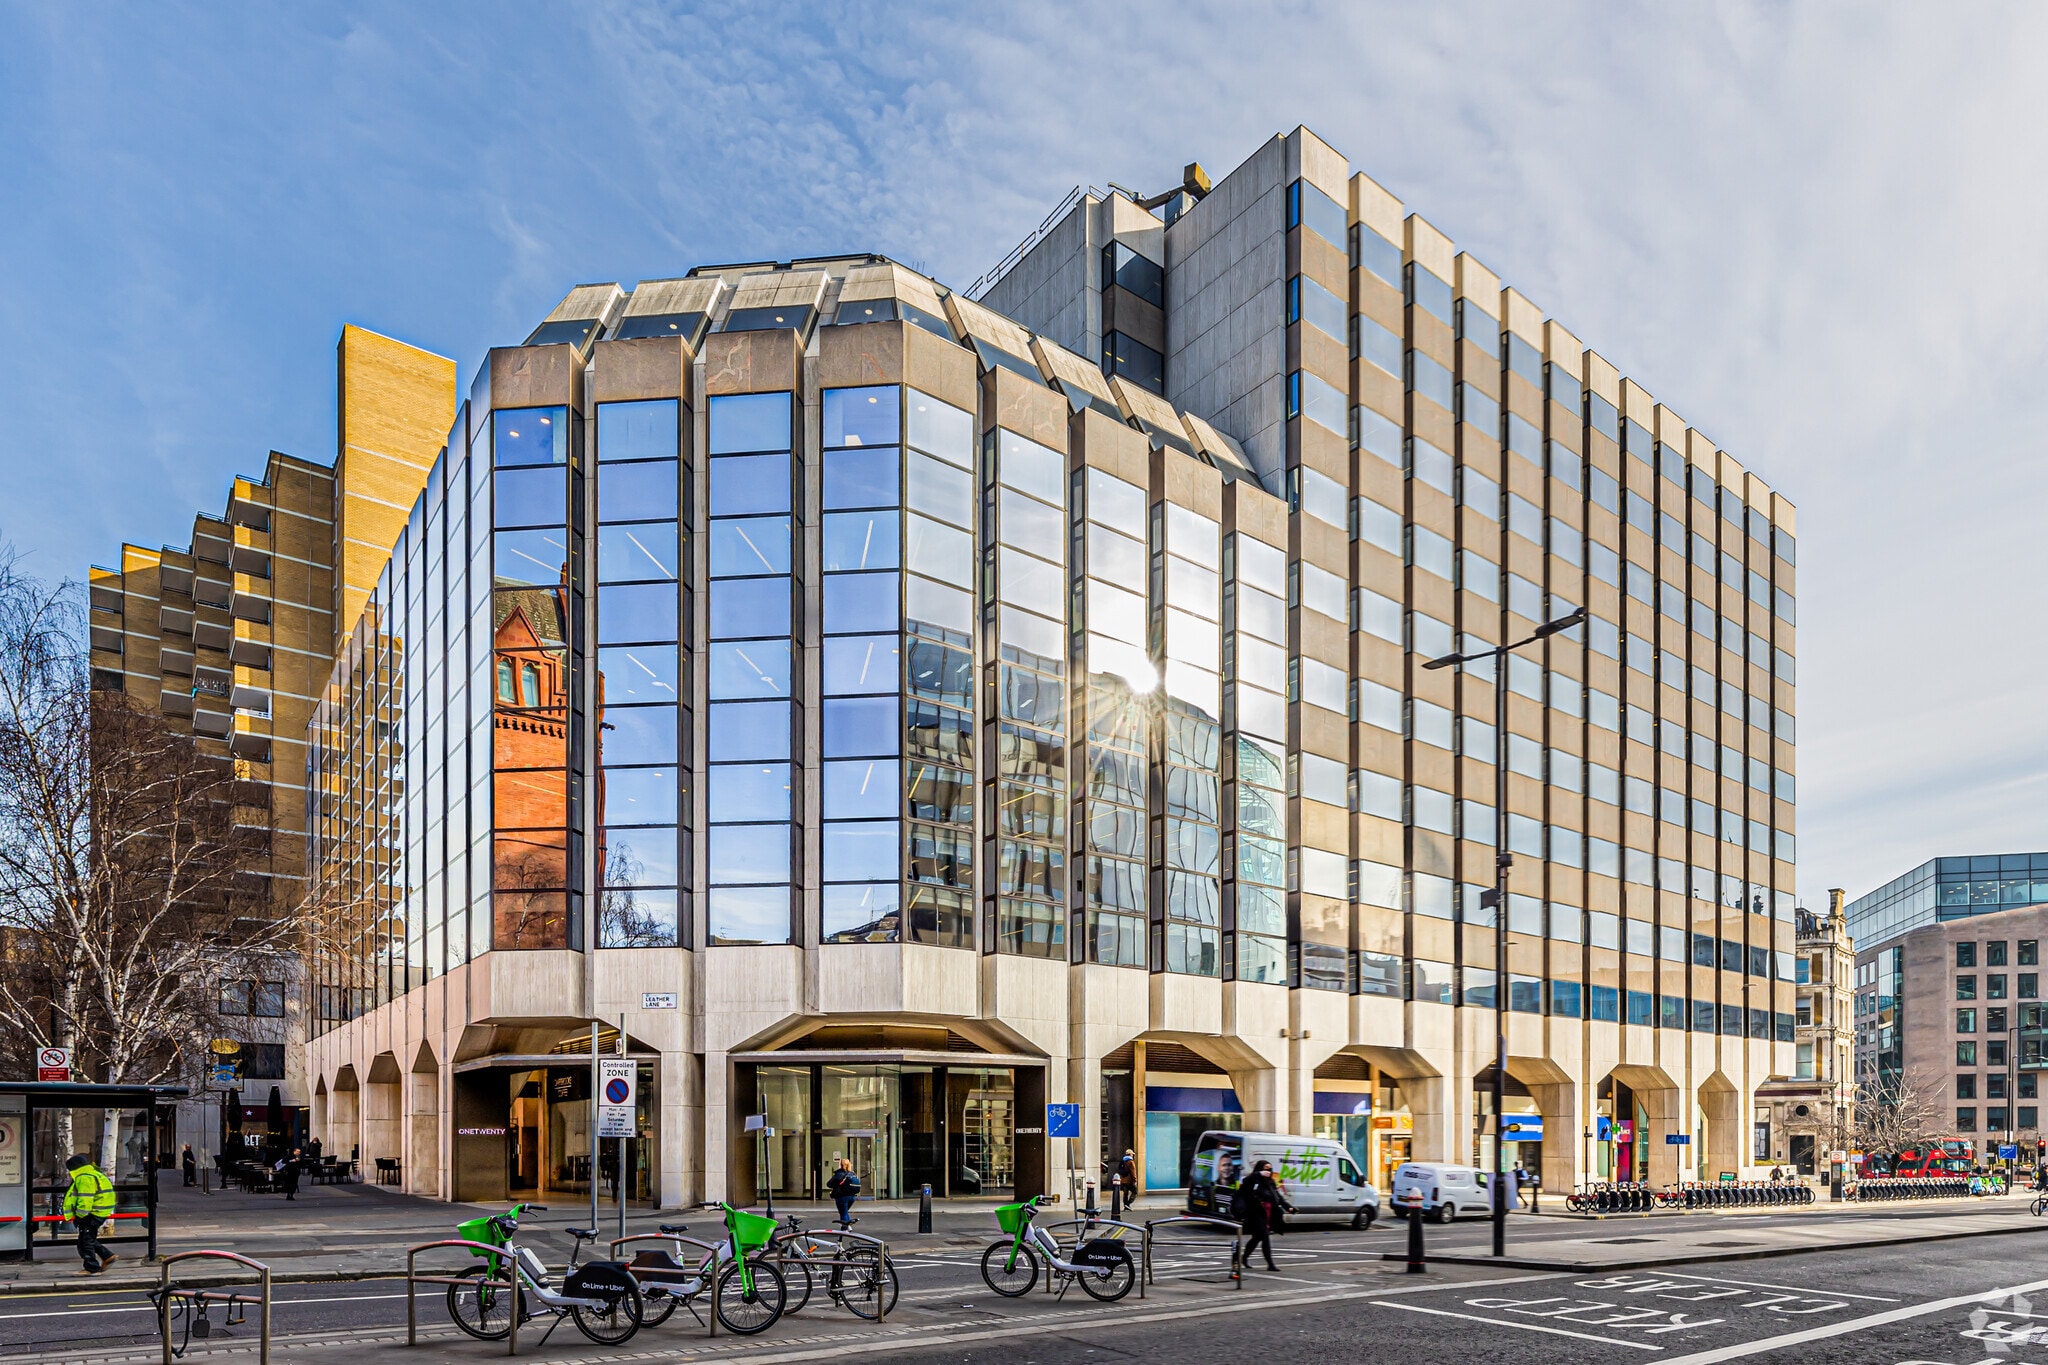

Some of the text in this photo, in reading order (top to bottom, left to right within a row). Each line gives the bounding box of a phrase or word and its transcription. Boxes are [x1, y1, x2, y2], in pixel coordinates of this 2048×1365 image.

[606, 1069, 629, 1077] ZONE
[1280, 1145, 1330, 1188] better
[590, 1282, 604, 1290] Lime
[1574, 1275, 1850, 1314] CLEAR
[1464, 1296, 1726, 1334] KEEP
